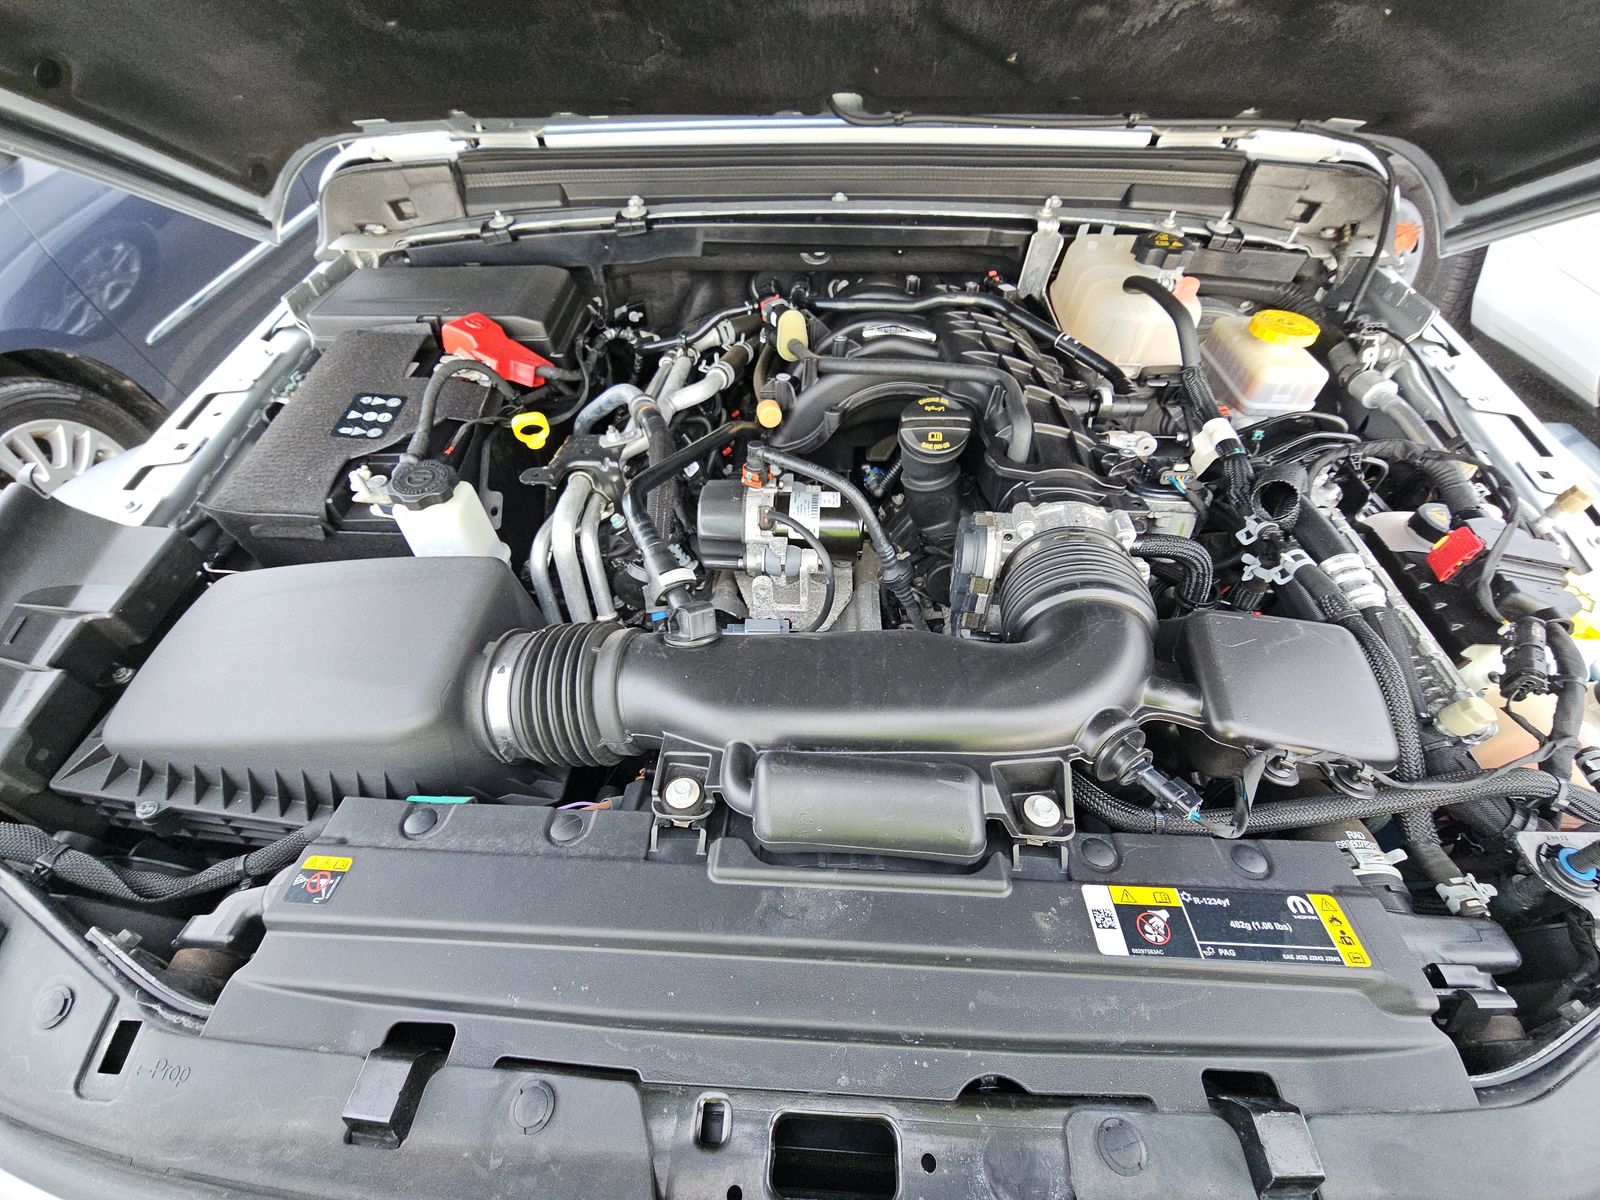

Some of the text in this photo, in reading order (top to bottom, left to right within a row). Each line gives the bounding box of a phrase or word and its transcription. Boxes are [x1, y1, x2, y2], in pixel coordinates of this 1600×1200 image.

[1345, 830, 1366, 840] RAD
[1192, 896, 1231, 908] R-1234yf
[1229, 920, 1252, 931] 482g
[1217, 948, 1237, 957] PAG
[150, 1057, 191, 1088] Prop
